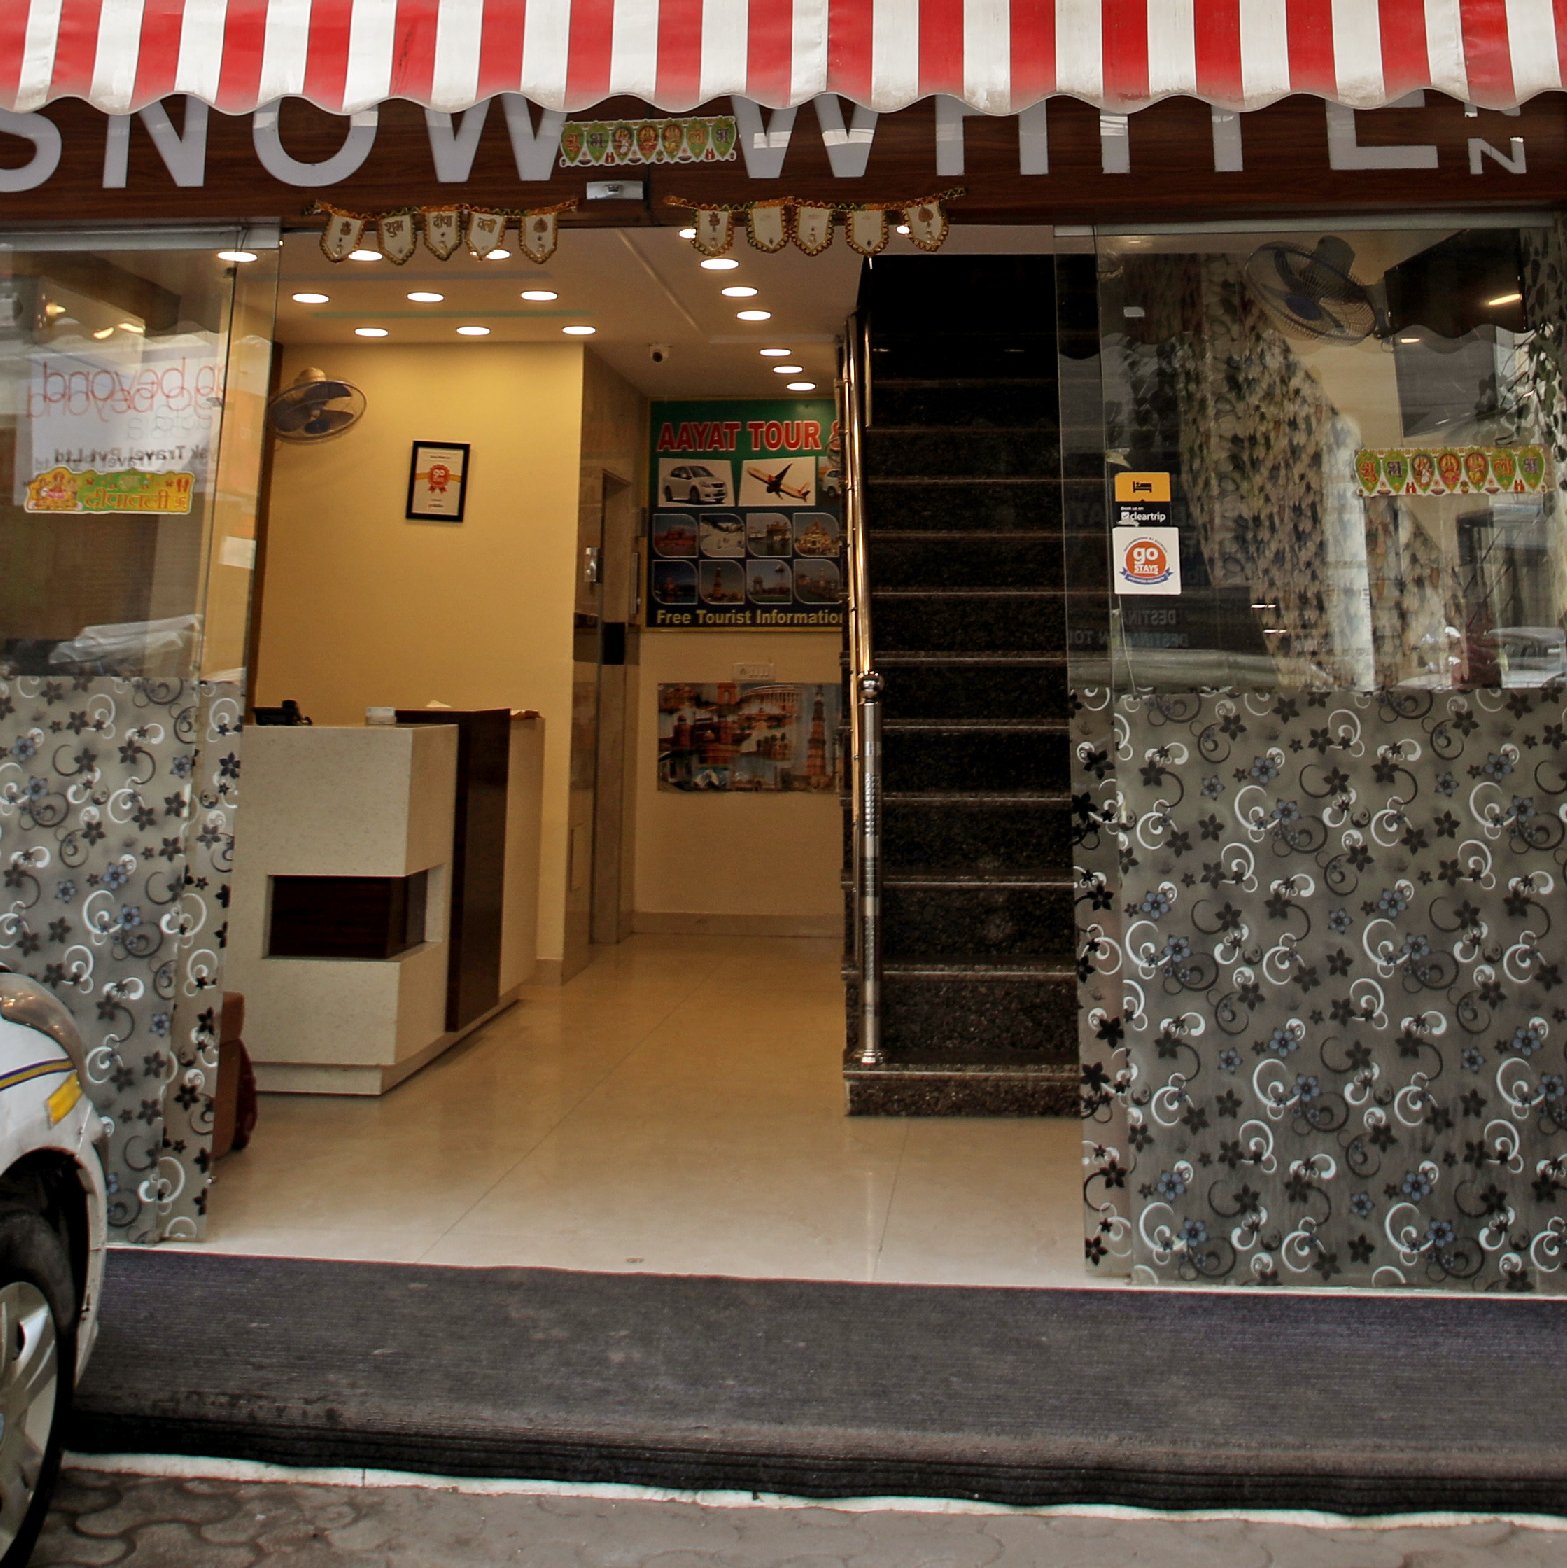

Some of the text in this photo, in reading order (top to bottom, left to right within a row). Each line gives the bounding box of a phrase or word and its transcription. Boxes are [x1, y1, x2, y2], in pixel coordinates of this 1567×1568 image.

[657, 420, 821, 452] AAYAT TOUR
[1131, 511, 1166, 523] cleartrip
[1133, 547, 1159, 565] go
[657, 610, 692, 625] Free
[696, 609, 751, 625] Tourist
